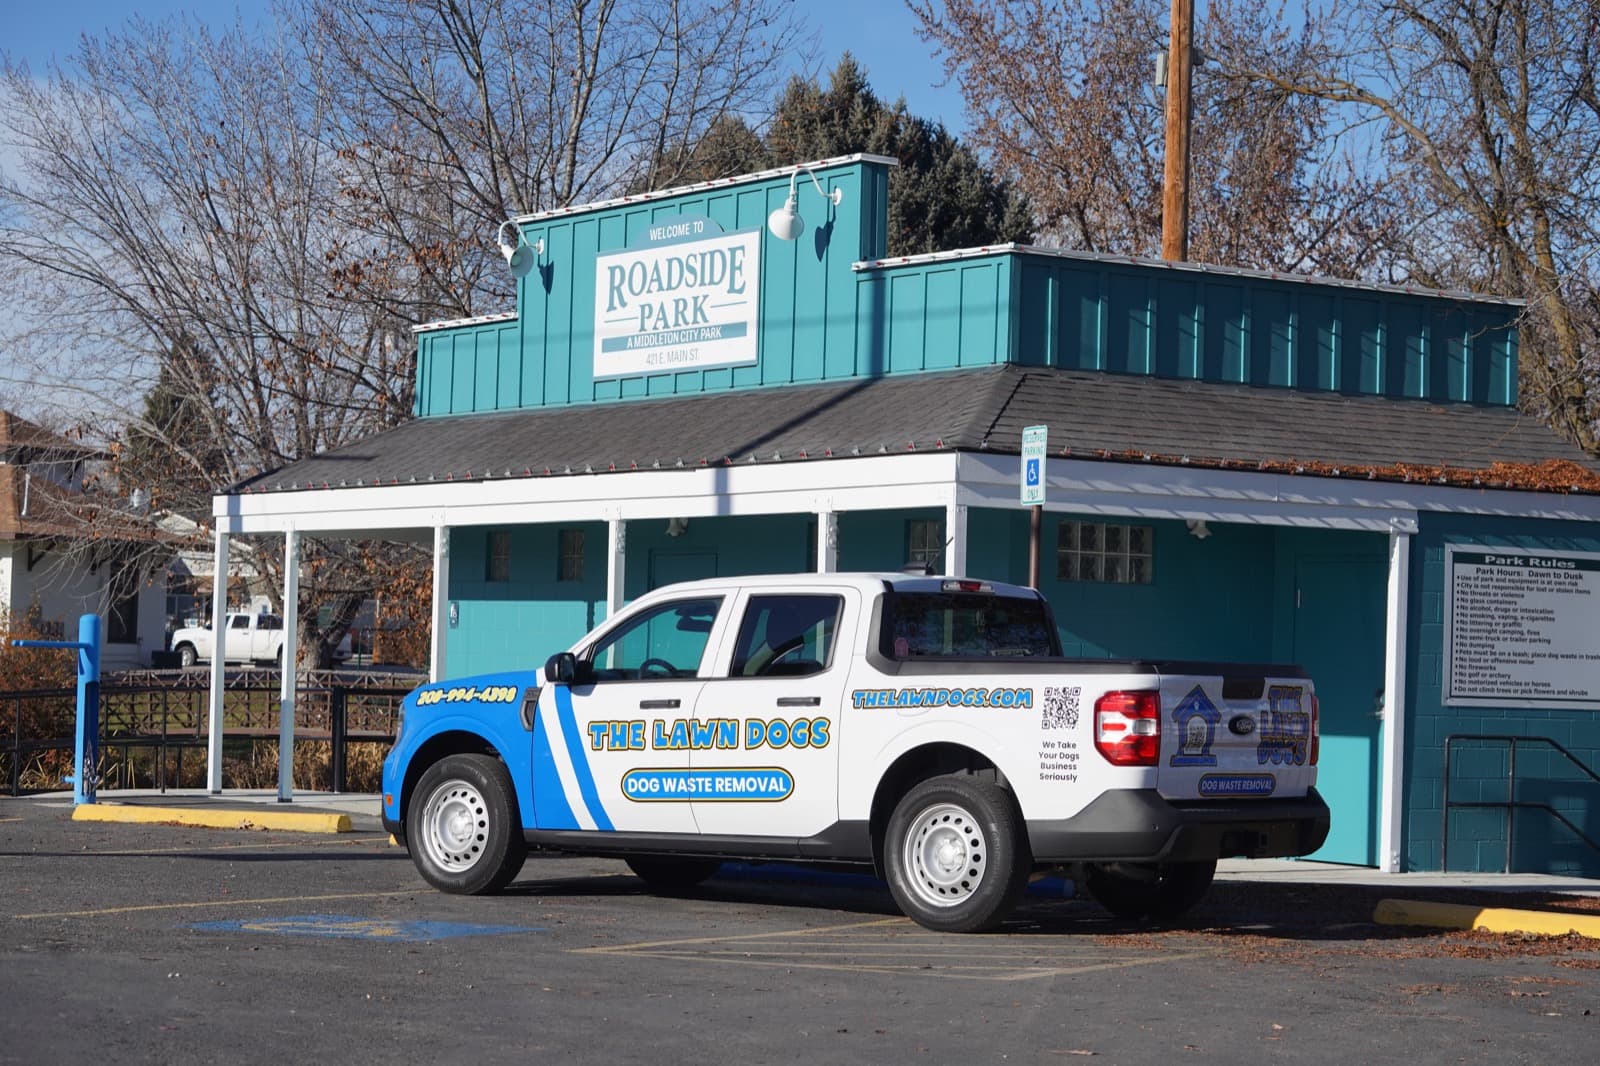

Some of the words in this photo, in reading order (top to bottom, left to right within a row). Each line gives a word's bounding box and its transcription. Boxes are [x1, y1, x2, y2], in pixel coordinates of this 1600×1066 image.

[650, 224, 690, 240] WELCOME
[693, 220, 704, 233] TO
[606, 245, 746, 312] ROADSIDE
[638, 294, 709, 332] PARK
[627, 338, 634, 348] A
[634, 332, 680, 348] MIDDLETON
[680, 330, 699, 342] CITY
[700, 326, 722, 339] PARK
[646, 354, 658, 366] 421
[667, 350, 688, 363] MAIN
[1485, 556, 1524, 566] Park
[1529, 558, 1576, 568] Rules
[1476, 568, 1494, 576] Park
[1497, 568, 1523, 576] Hours:
[1564, 572, 1583, 580] Dusk
[852, 688, 1034, 709] THELAWNDOGS.COM
[1268, 686, 1302, 712] THE
[588, 720, 646, 752] THE
[652, 718, 740, 750] LAWN
[744, 717, 831, 750] DOGS
[1260, 710, 1309, 740] LAWN
[1038, 752, 1058, 760] Your
[1059, 752, 1080, 762] Dogs
[1257, 739, 1306, 766] DOGS
[1040, 762, 1077, 770] Business
[628, 778, 660, 792] DOG
[663, 778, 712, 792] WASTE
[716, 777, 786, 792] REMOVAL
[1040, 772, 1078, 782] Seriously
[1202, 781, 1218, 790] DOG
[1218, 780, 1242, 790] WASTE
[1242, 780, 1272, 790] REMOVAL
